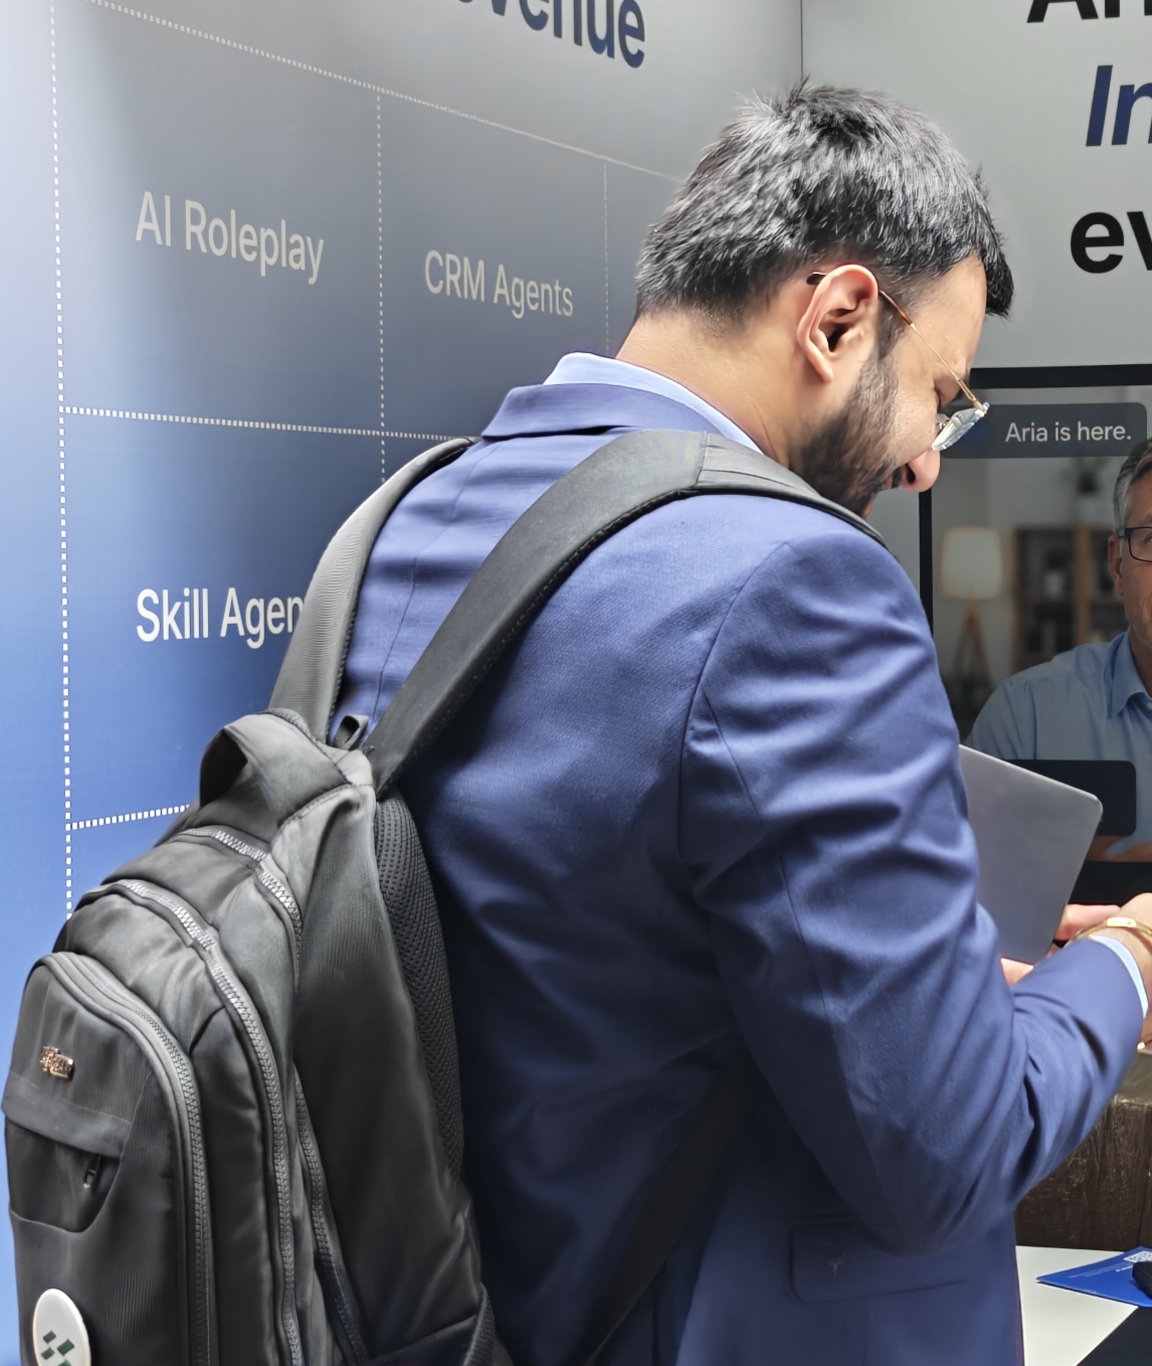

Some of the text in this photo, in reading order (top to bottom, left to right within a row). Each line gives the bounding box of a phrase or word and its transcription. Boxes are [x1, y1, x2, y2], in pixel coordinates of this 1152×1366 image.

[136, 191, 324, 285] AI Roleplay
[424, 249, 574, 319] CRM Agents
[1005, 420, 1132, 442] Aria is here.
[136, 588, 209, 643] Skill
